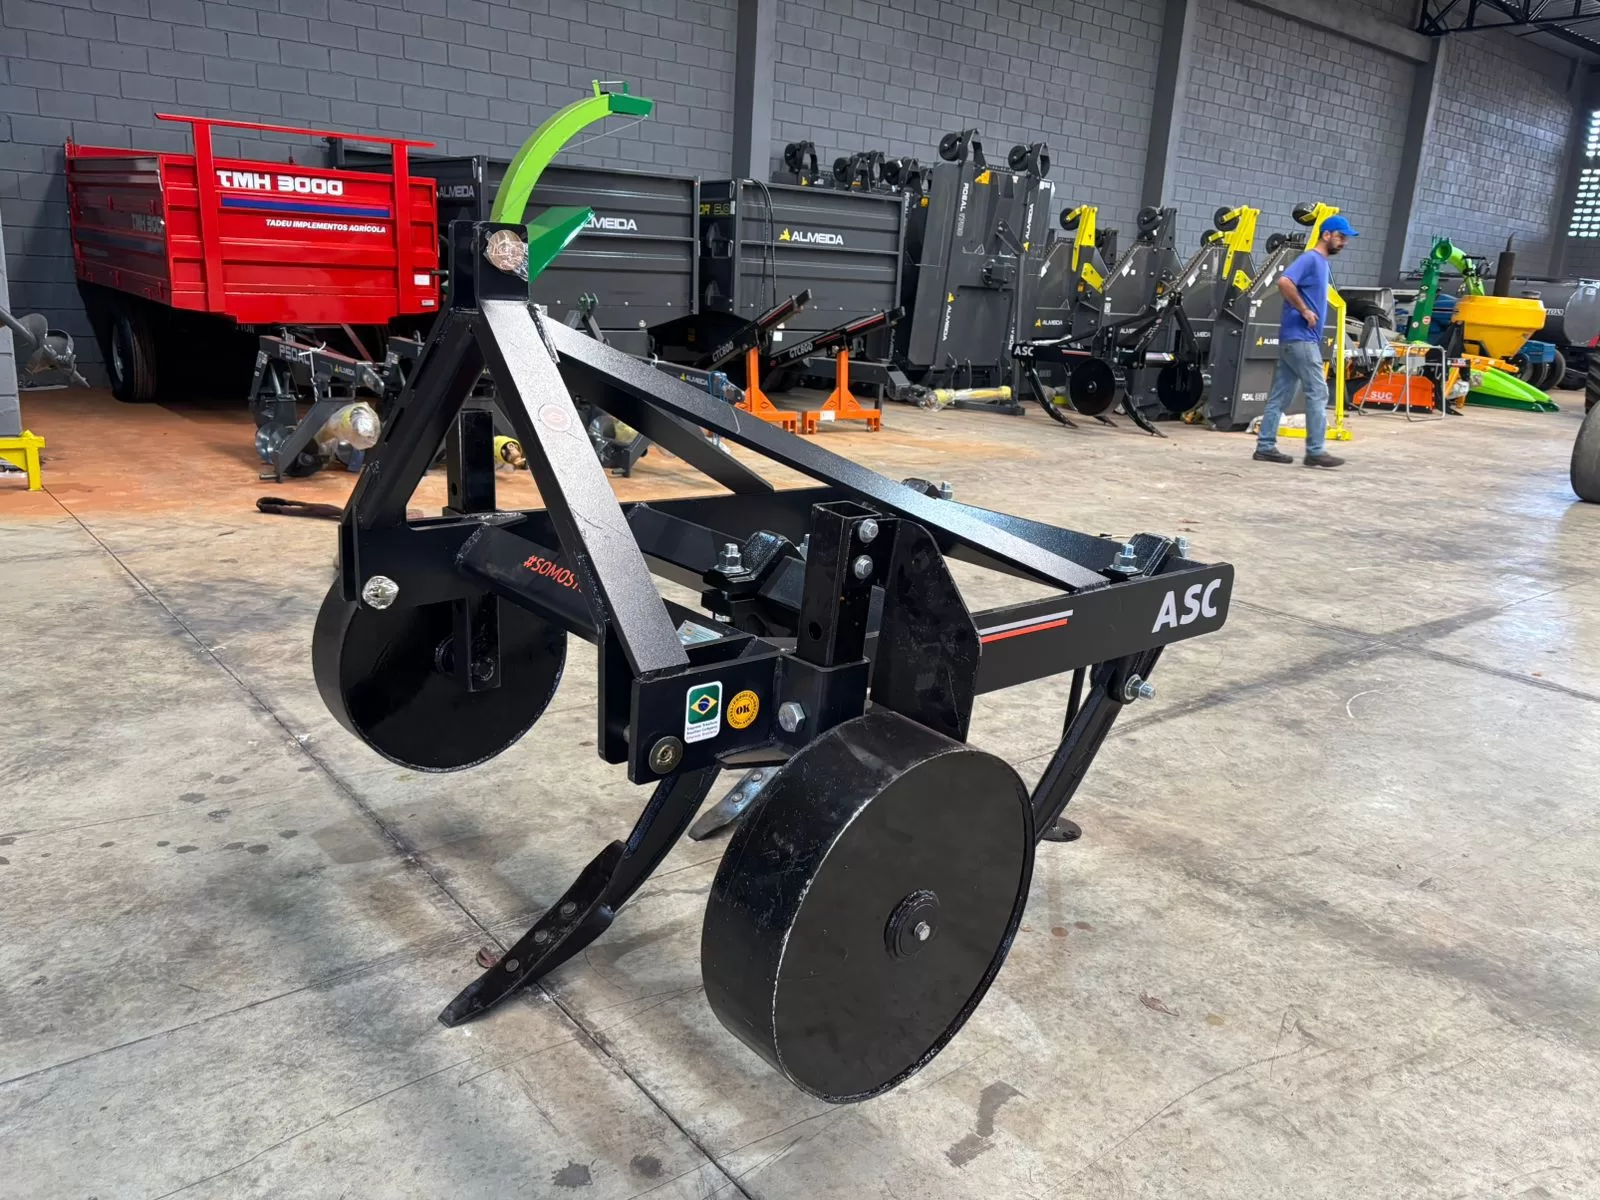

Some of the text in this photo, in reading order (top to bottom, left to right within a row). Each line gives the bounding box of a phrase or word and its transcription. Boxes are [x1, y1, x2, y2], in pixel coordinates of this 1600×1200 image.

[216, 170, 343, 196] TMH 3000
[439, 184, 475, 198] ALMEIDA
[265, 218, 293, 228] TADEU
[293, 219, 348, 231] IMPLEMENTOS
[582, 215, 637, 231] LMEIDA
[791, 230, 844, 245] ALMEIDA
[1013, 345, 1034, 357] ASC
[1370, 390, 1393, 401] SUC
[1151, 578, 1222, 633] ASC
[735, 704, 750, 715] OK
